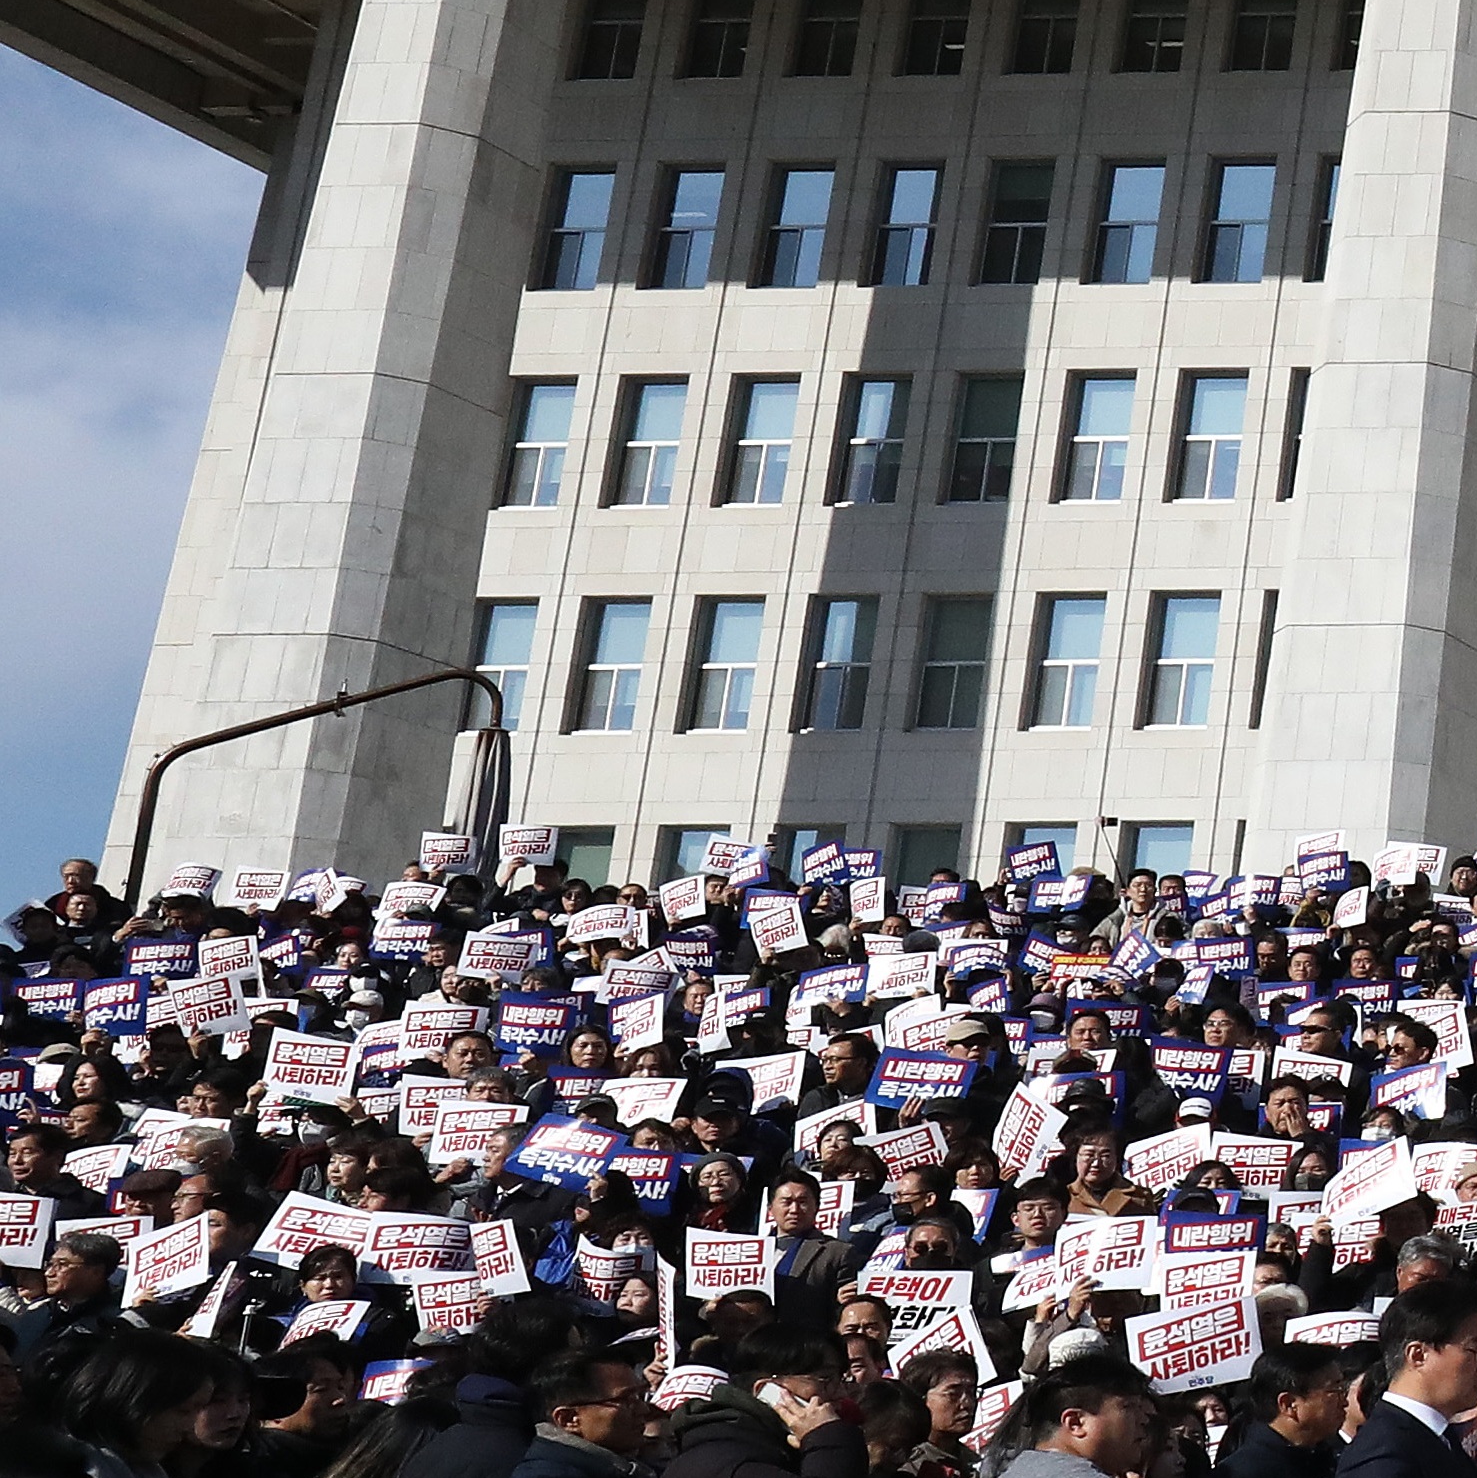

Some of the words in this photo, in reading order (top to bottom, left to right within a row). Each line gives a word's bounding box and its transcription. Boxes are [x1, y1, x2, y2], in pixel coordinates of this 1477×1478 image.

[131, 942, 191, 960] 내란행위
[131, 959, 193, 975] 즉각수사!
[273, 1040, 350, 1068] 윤석열은
[1155, 1045, 1228, 1072] 내란행위
[271, 1063, 348, 1090] 사퇴하라!
[885, 1058, 971, 1083] 내란행위
[528, 1124, 614, 1156] 내란행위
[517, 1147, 604, 1179] 즉각수사!
[137, 1225, 203, 1270] 윤석열은
[376, 1224, 470, 1250] 윤석열은
[375, 1246, 468, 1272] 사퇴하라!
[693, 1241, 760, 1266] 윤석열은
[693, 1264, 767, 1287] 사퇴하라!
[865, 1277, 954, 1301] 탄핵이
[1141, 1303, 1244, 1357] 윤석열은
[1150, 1335, 1250, 1383] 사퇴하라!
